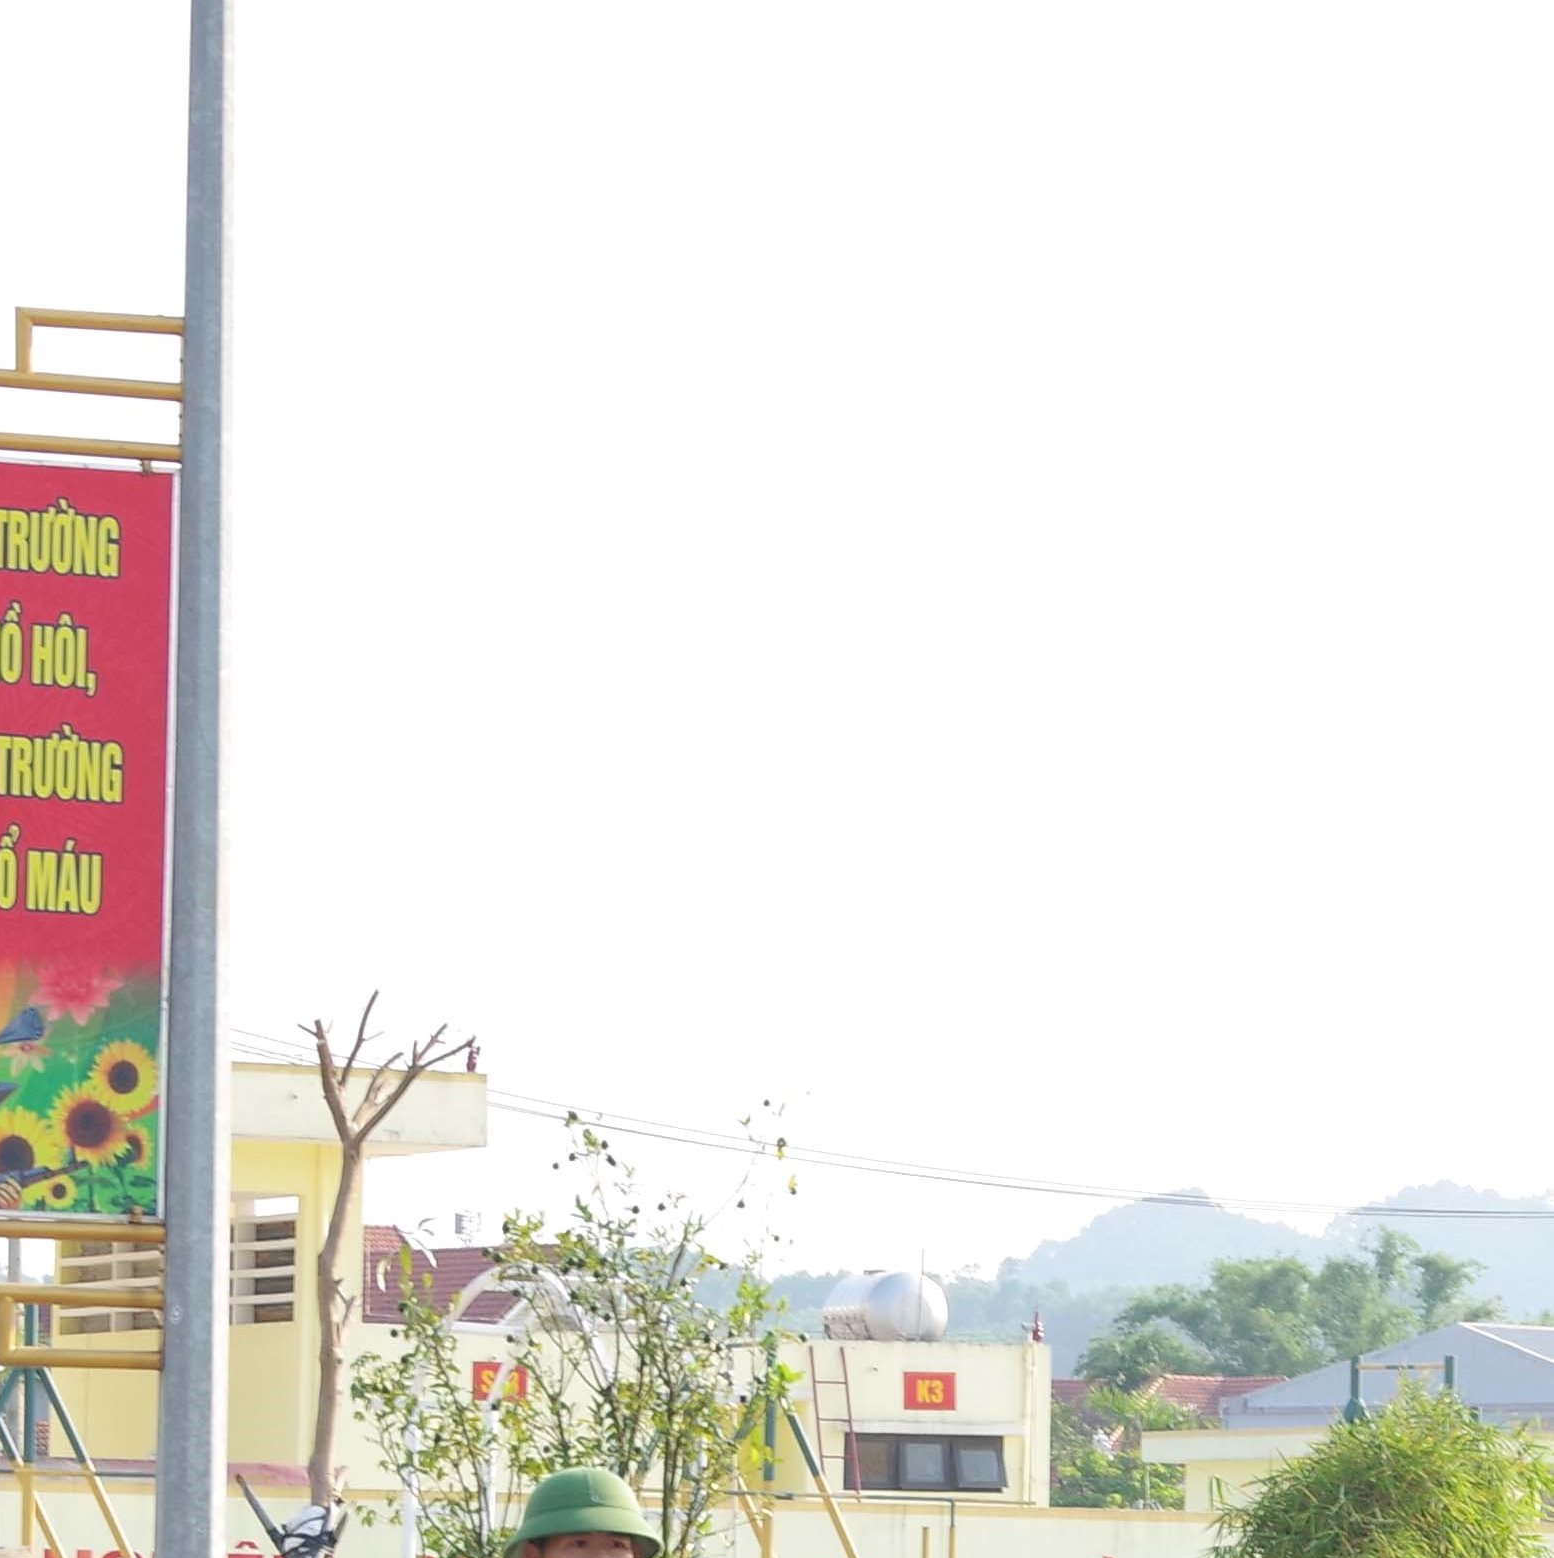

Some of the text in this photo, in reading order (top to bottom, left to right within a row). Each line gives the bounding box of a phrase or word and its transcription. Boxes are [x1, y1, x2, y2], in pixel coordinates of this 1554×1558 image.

[30, 613, 98, 697] HÔI,
[26, 840, 103, 915] MÁU
[915, 1379, 946, 1404] K3
